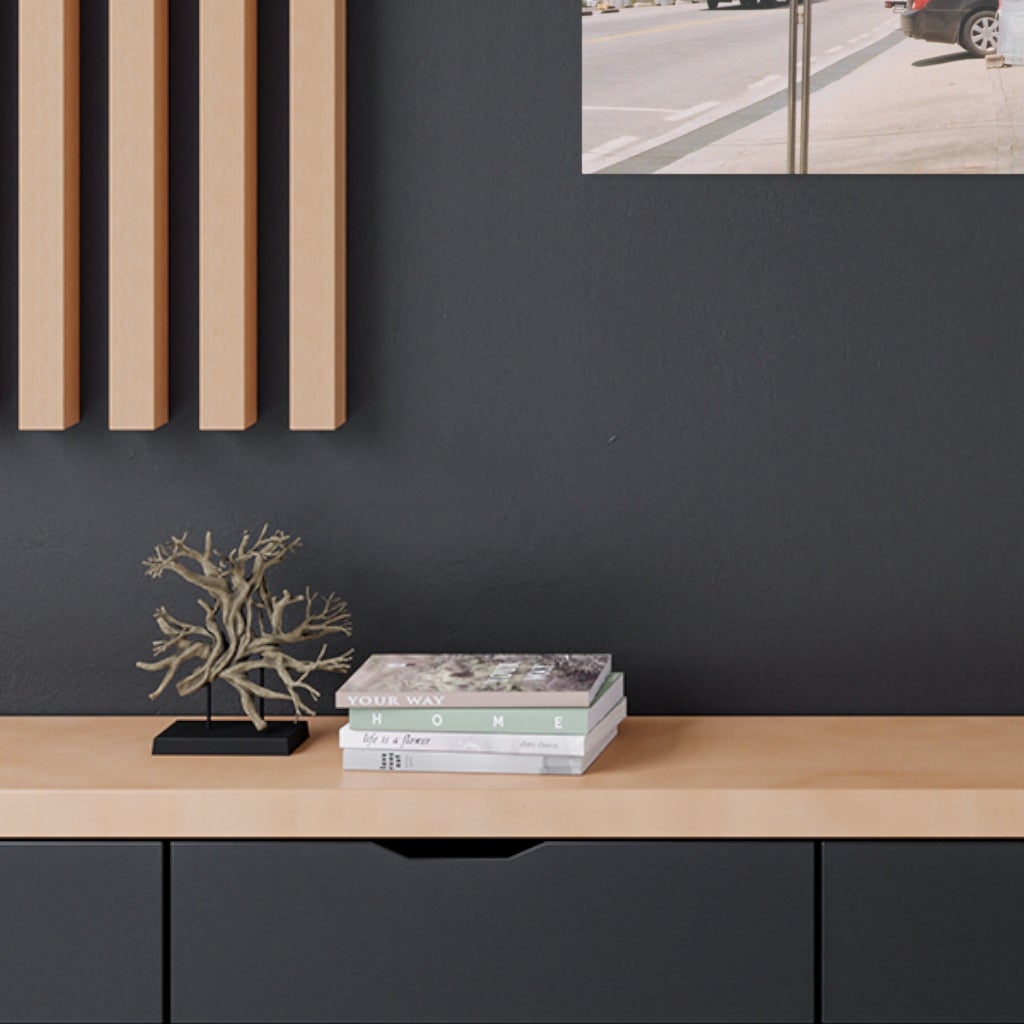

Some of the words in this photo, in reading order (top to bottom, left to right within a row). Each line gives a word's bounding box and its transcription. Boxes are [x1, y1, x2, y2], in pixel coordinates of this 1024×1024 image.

[347, 695, 399, 707] YOUR
[406, 695, 445, 707] WAY
[372, 712, 564, 730] HOME
[362, 732, 379, 746] life
[399, 733, 431, 748] flower
